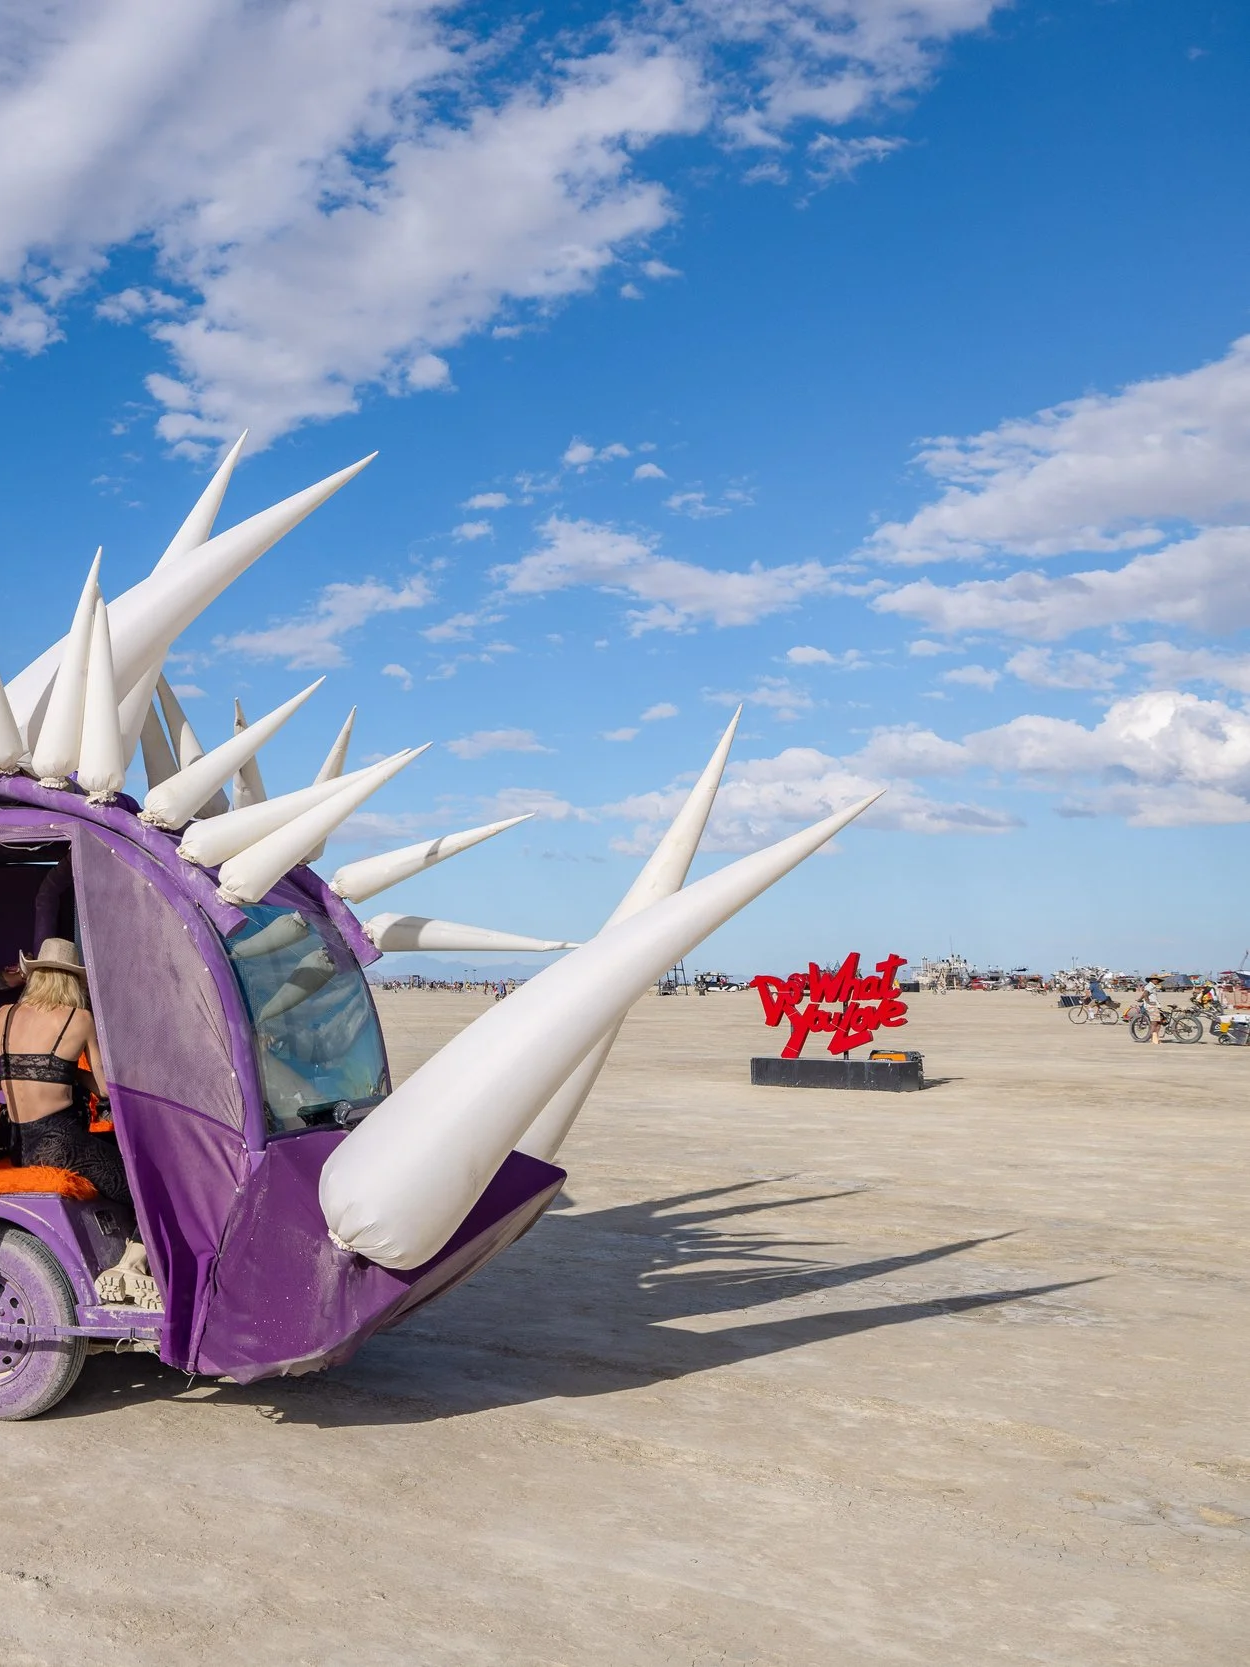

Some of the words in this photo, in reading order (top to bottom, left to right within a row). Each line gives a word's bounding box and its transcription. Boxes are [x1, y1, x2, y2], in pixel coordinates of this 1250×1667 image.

[750, 973, 810, 1027] Do
[809, 952, 908, 1003] What
[781, 1003, 843, 1058] You
